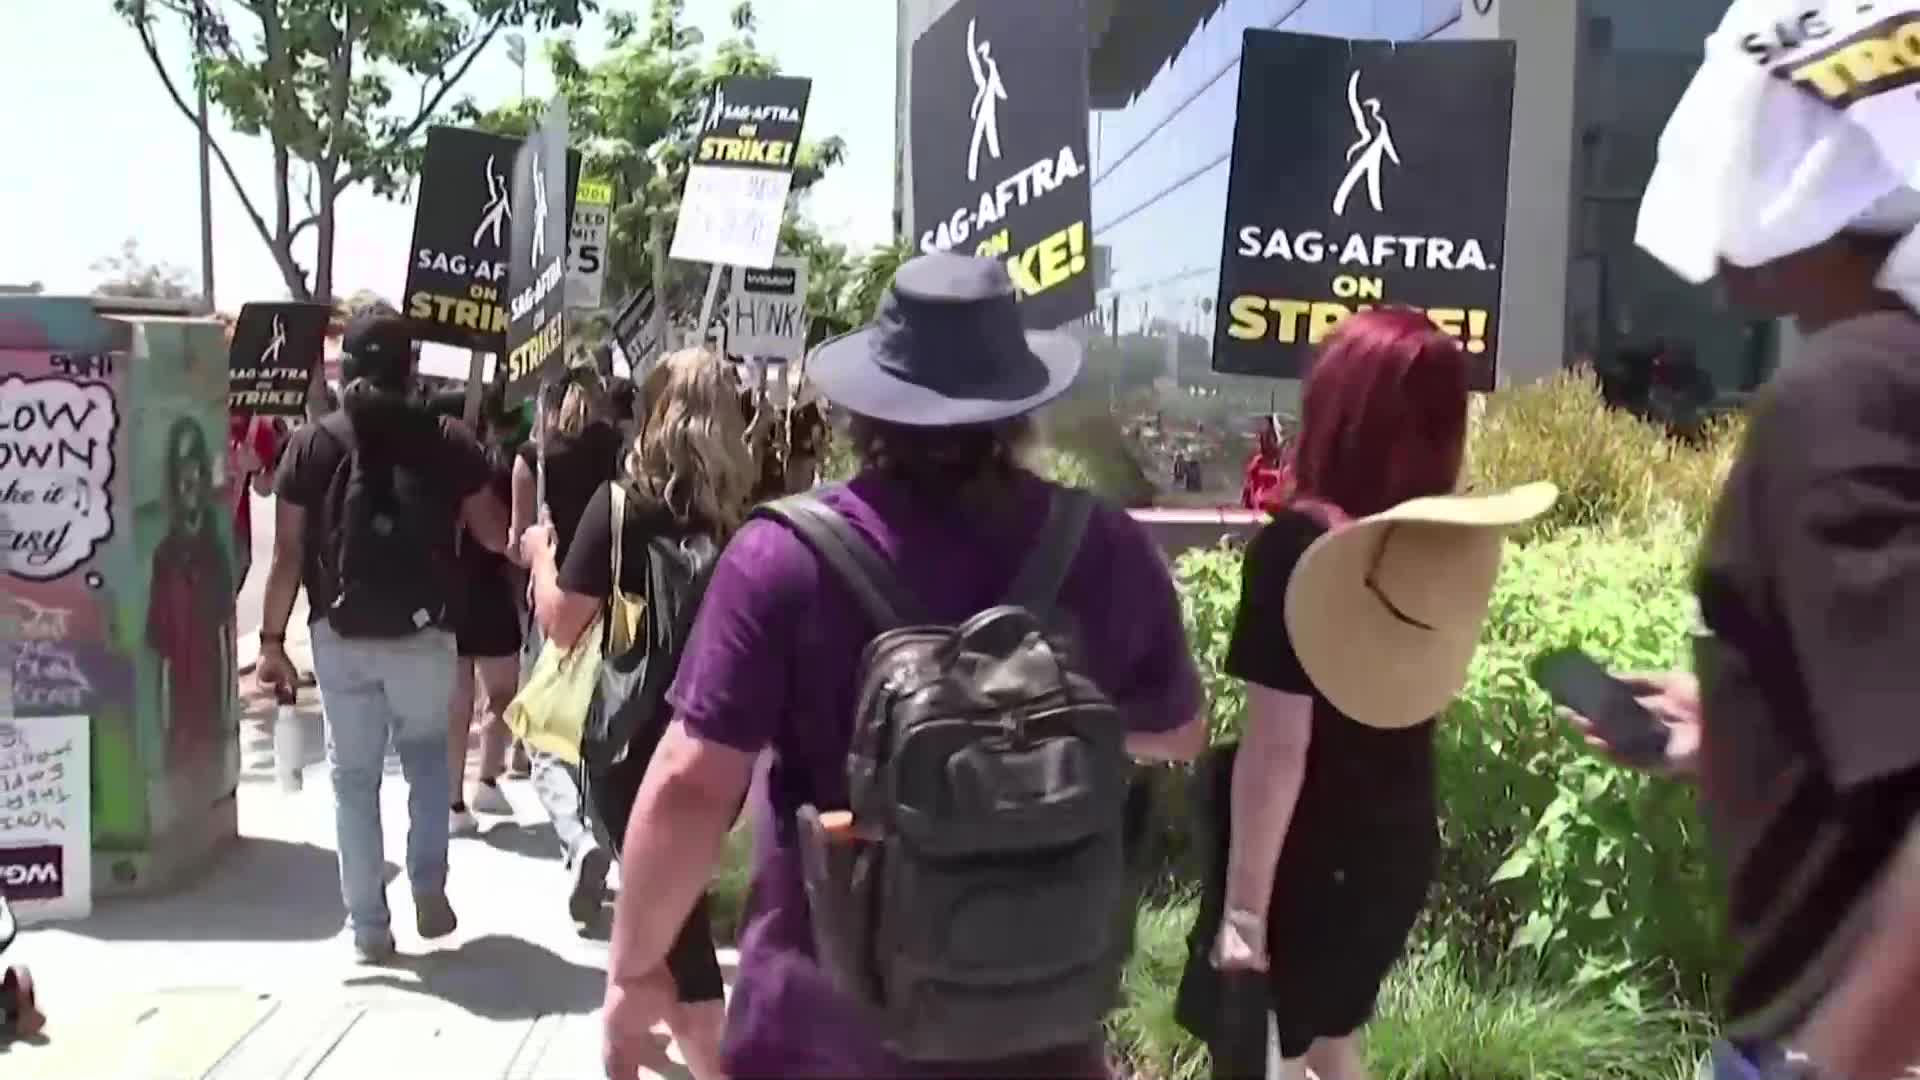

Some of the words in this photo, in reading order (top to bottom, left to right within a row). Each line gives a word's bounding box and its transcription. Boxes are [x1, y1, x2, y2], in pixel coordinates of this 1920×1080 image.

[700, 137, 793, 165] STRIKE!
[469, 284, 498, 302] ON
[1332, 274, 1384, 300] ON
[1227, 295, 1488, 354] STRIE!
[509, 311, 562, 383] STRIKE!
